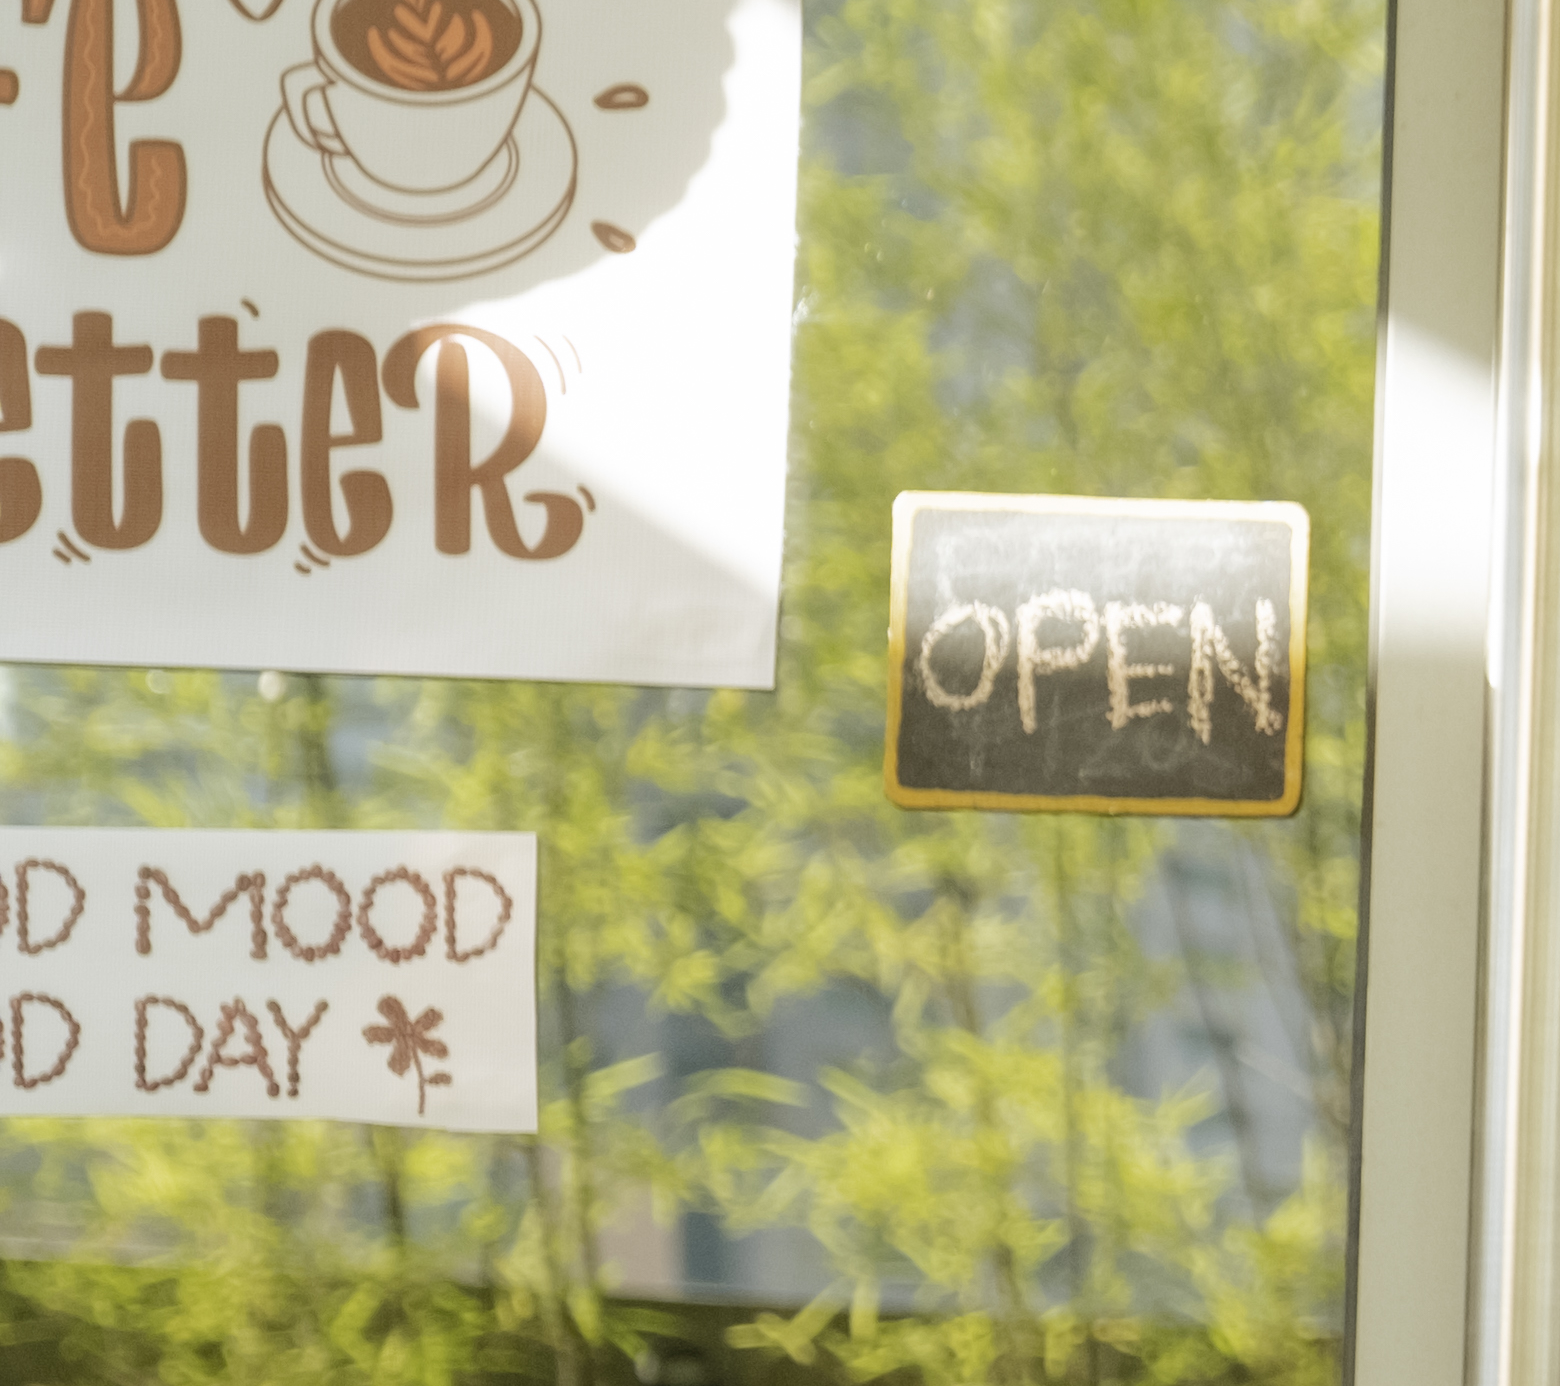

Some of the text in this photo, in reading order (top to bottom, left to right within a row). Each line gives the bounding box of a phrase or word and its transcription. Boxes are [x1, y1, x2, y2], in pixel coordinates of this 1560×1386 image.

[920, 587, 1283, 745] OPEN
[0, 856, 513, 963] D MOOD
[135, 995, 329, 1098] DAY
